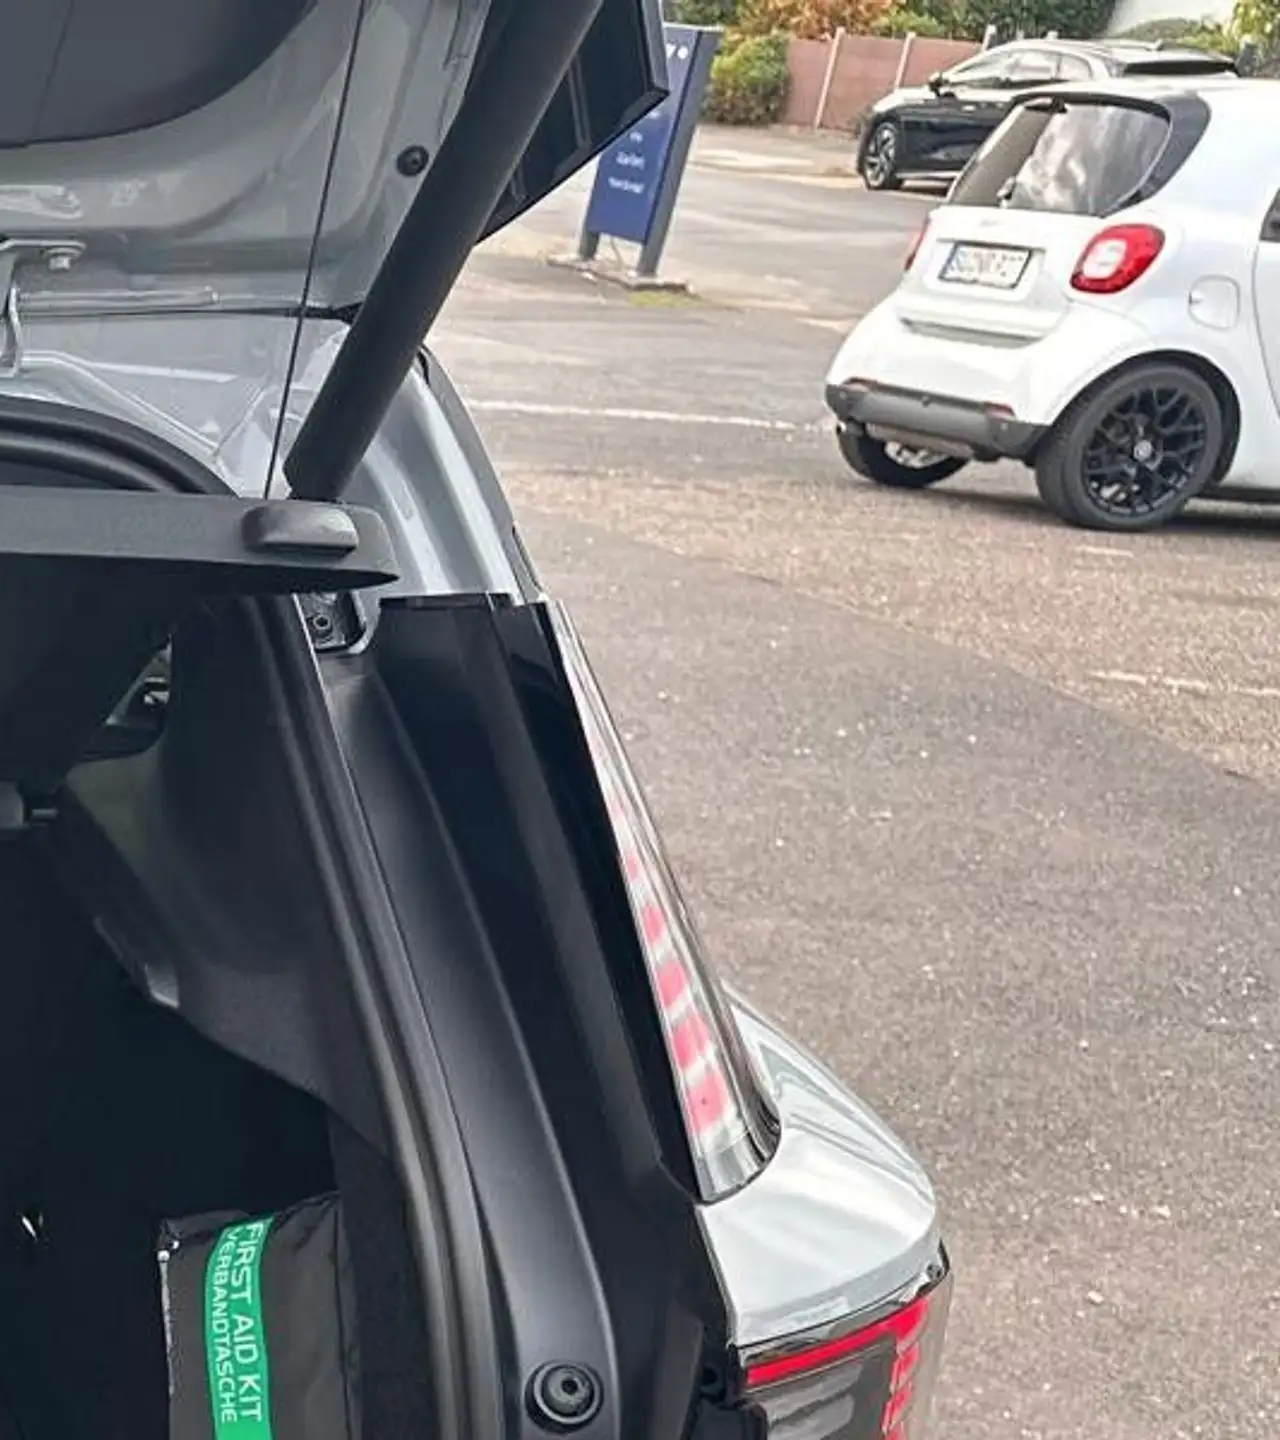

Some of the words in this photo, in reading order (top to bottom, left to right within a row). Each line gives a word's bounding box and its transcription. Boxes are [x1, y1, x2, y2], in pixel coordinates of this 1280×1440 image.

[230, 1222, 264, 1305] FIRST
[212, 1226, 241, 1424] VERBANDTASCHE
[232, 1313, 260, 1365] AID
[238, 1374, 262, 1422] KIT
